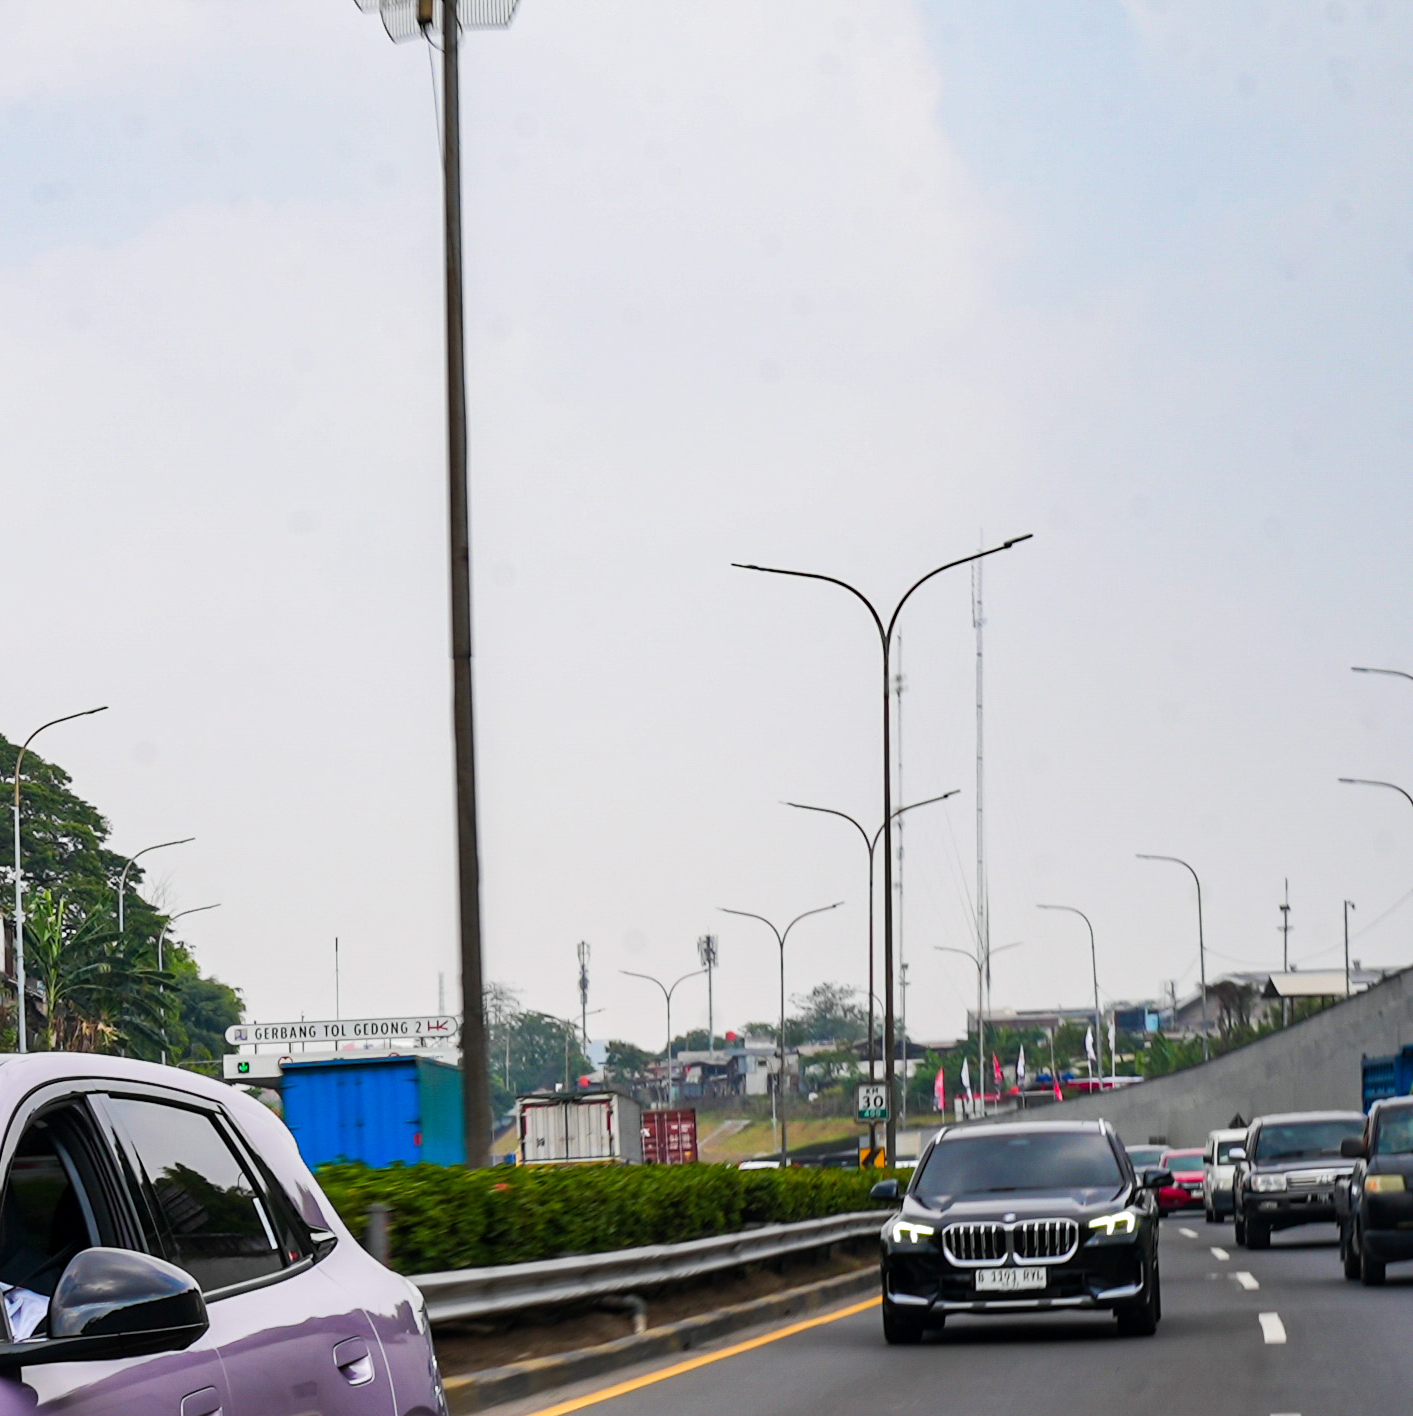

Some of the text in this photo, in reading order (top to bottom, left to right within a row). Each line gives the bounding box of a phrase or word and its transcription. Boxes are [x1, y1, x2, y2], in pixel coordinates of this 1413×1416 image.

[255, 1025, 316, 1040] GERBANG
[324, 1023, 347, 1037] TOL
[354, 1021, 408, 1036] GEDONG
[415, 1021, 422, 1034] 2
[866, 1087, 879, 1095] KM
[862, 1095, 884, 1109] 30
